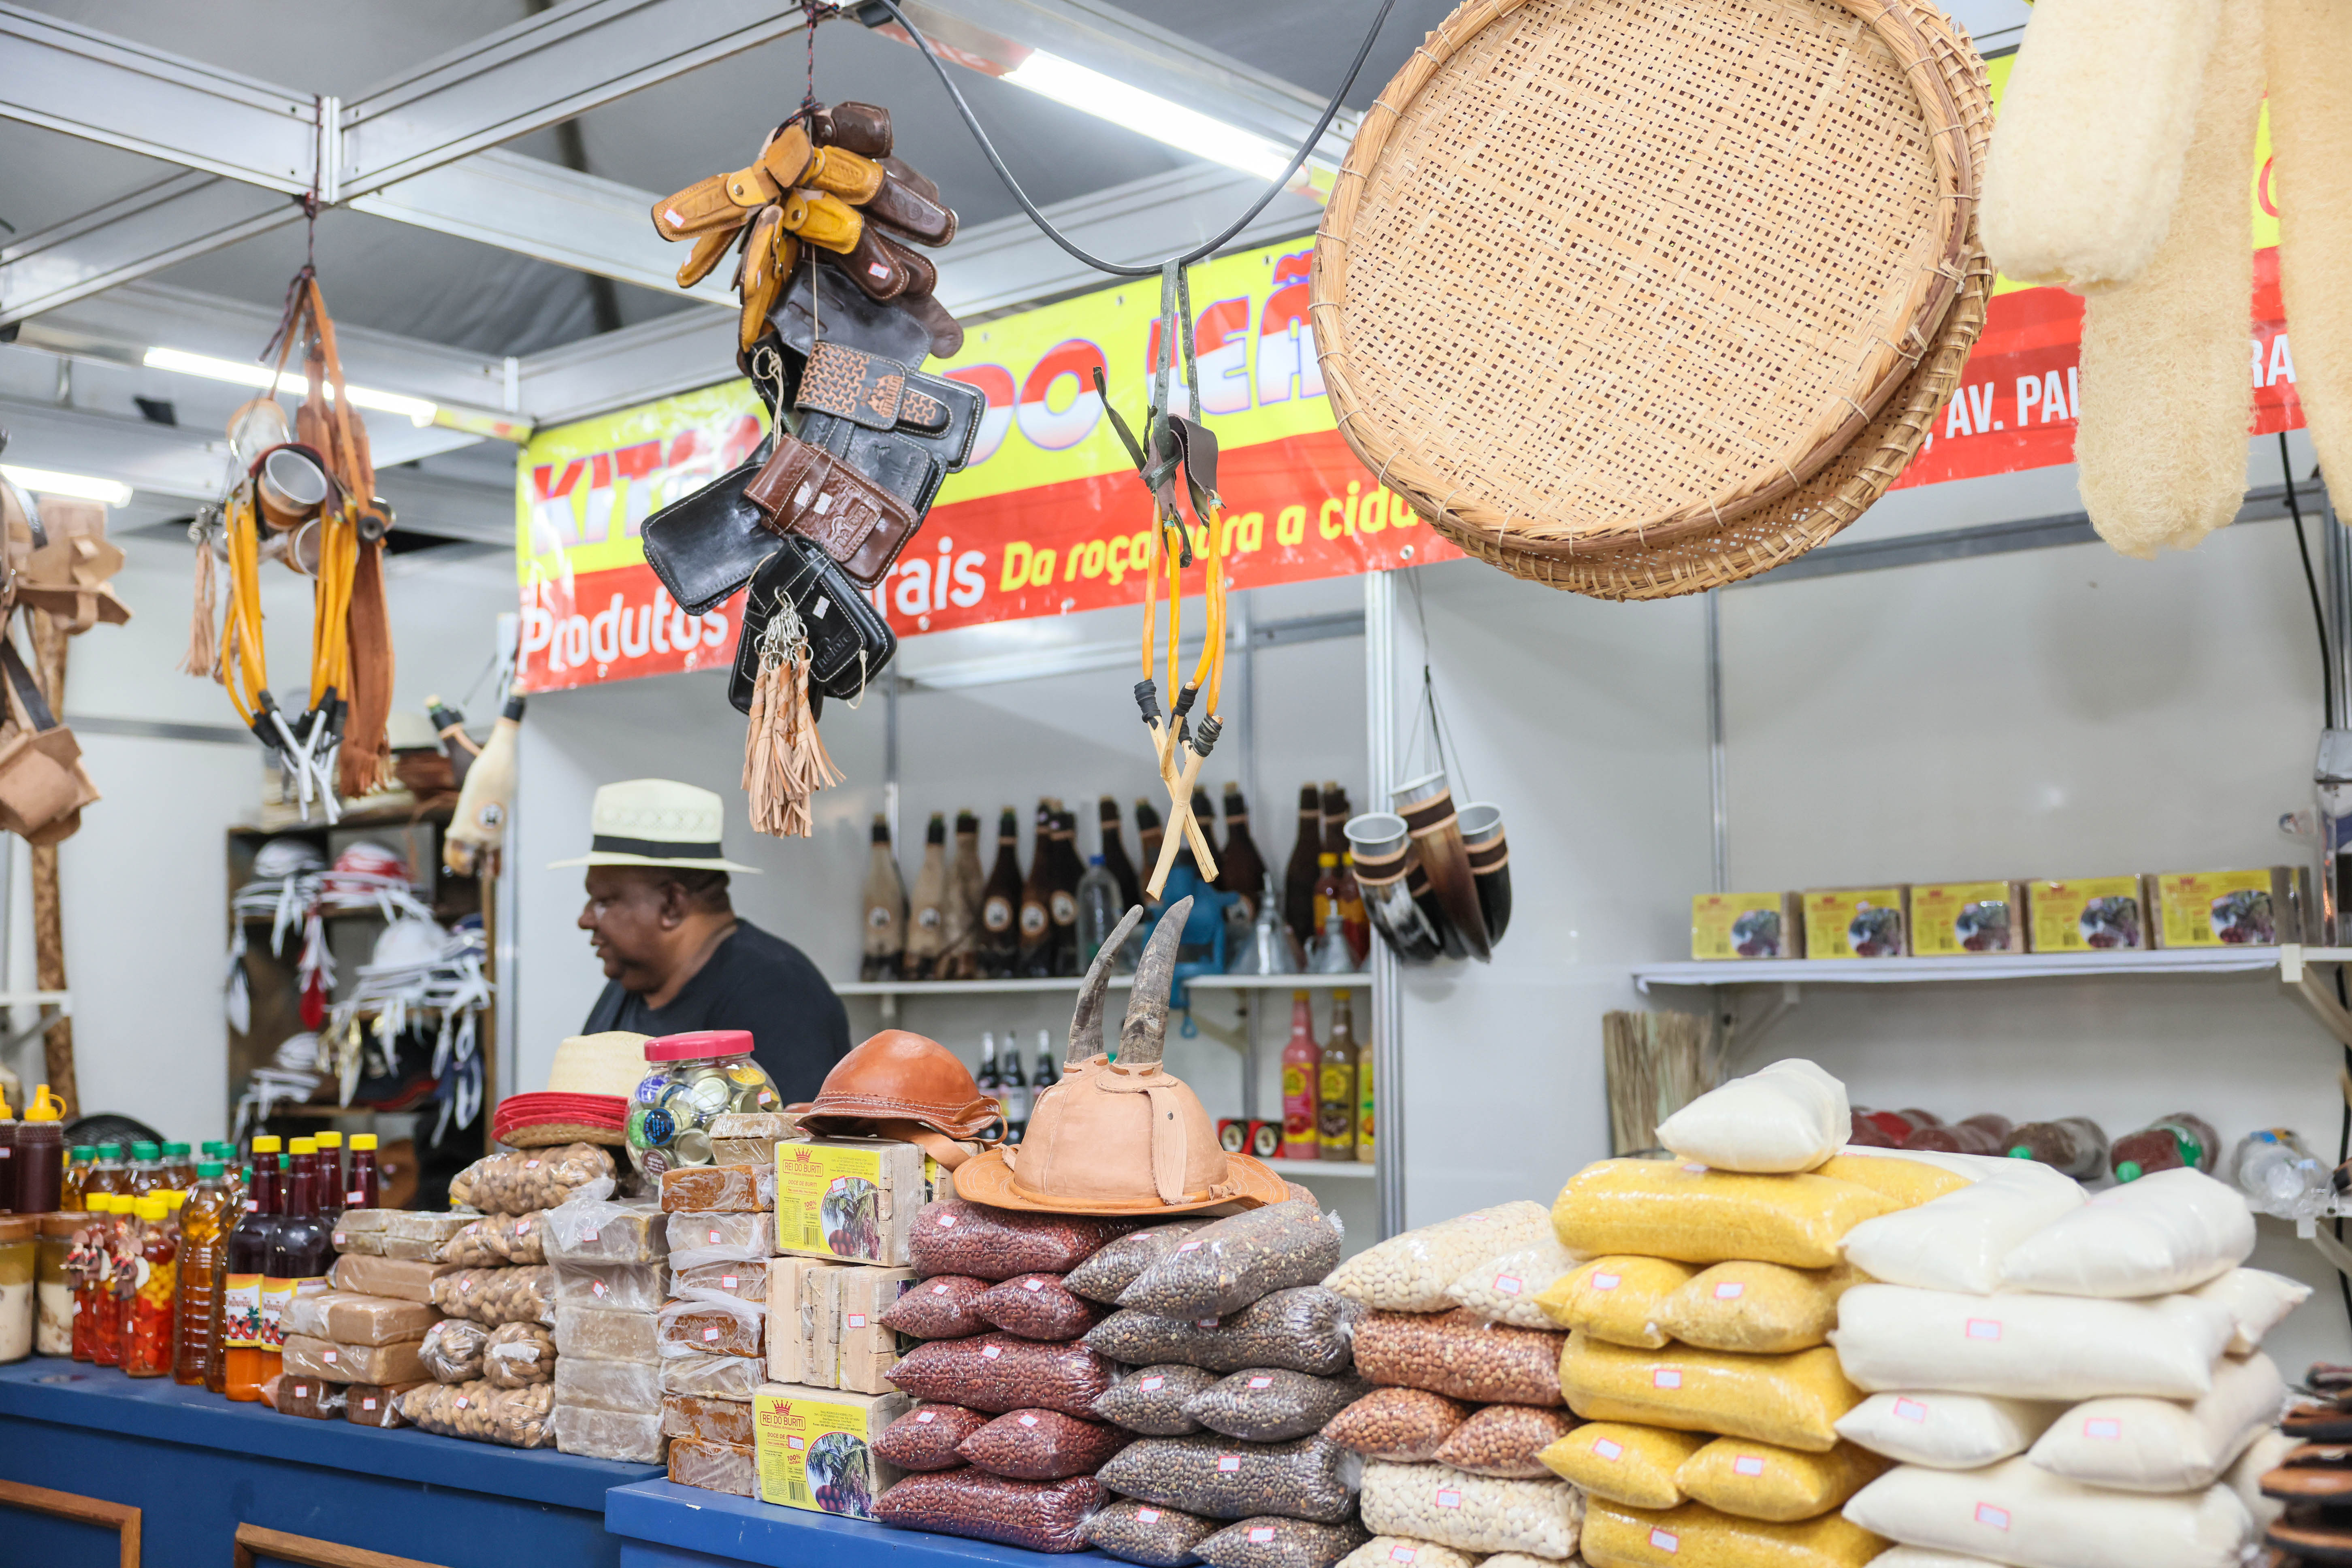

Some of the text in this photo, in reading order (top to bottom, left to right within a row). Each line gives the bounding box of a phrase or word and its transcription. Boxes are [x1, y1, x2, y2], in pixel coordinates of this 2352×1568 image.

[1945, 381, 2004, 439] AV.
[999, 540, 1056, 592] Da
[1064, 529, 1153, 586] roça
[1276, 504, 1307, 547] a
[519, 536, 986, 675] Produtos rais
[784, 1162, 793, 1171] REI
[795, 1163, 802, 1172] DO
[804, 1164, 821, 1174] BURITI
[804, 1199, 817, 1208] 100%
[763, 1414, 803, 1427] REI DO BURITI
[787, 1453, 801, 1461] 100%
